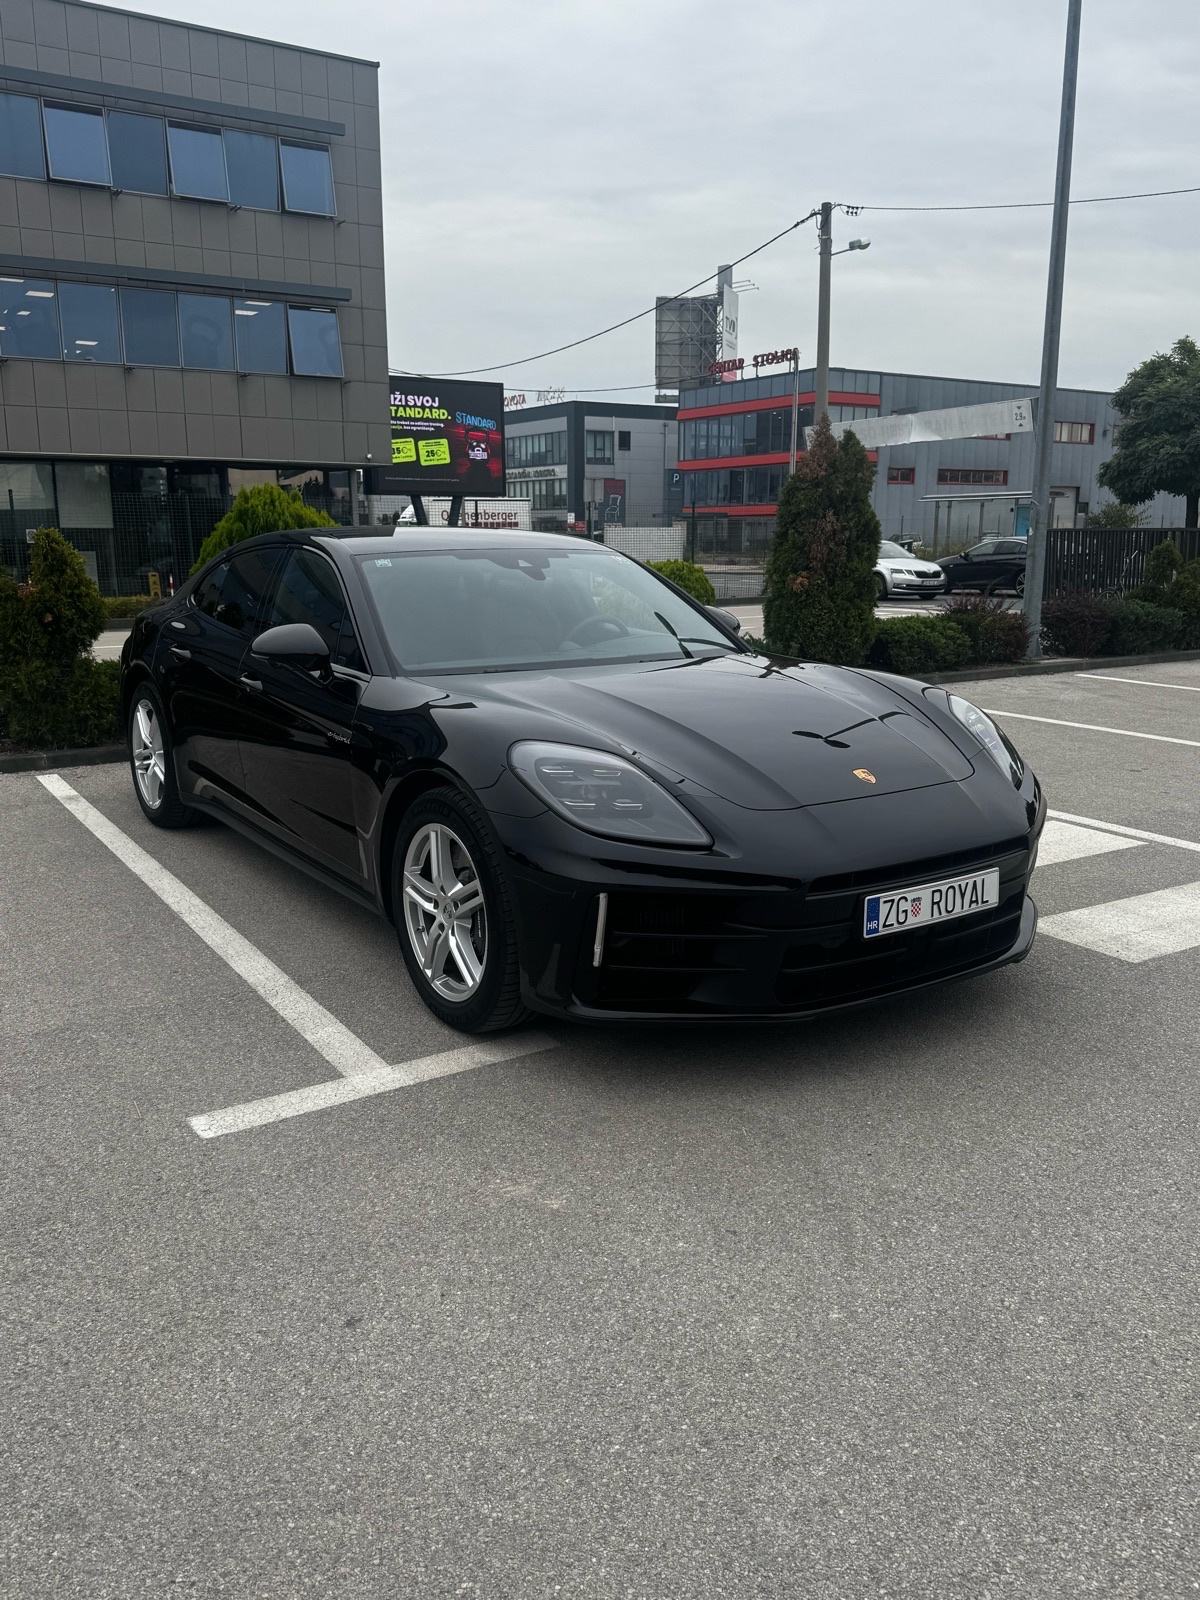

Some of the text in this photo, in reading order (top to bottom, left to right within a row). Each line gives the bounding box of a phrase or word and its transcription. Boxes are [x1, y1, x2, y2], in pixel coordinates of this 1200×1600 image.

[390, 391, 439, 407] IŽI SVOJ
[504, 393, 526, 407] OYOTA
[390, 406, 452, 420] TANDARD.
[455, 411, 497, 430] STANDARD
[673, 473, 680, 485] P
[882, 878, 989, 929] ZG ROYAL
[867, 920, 878, 931] HR
